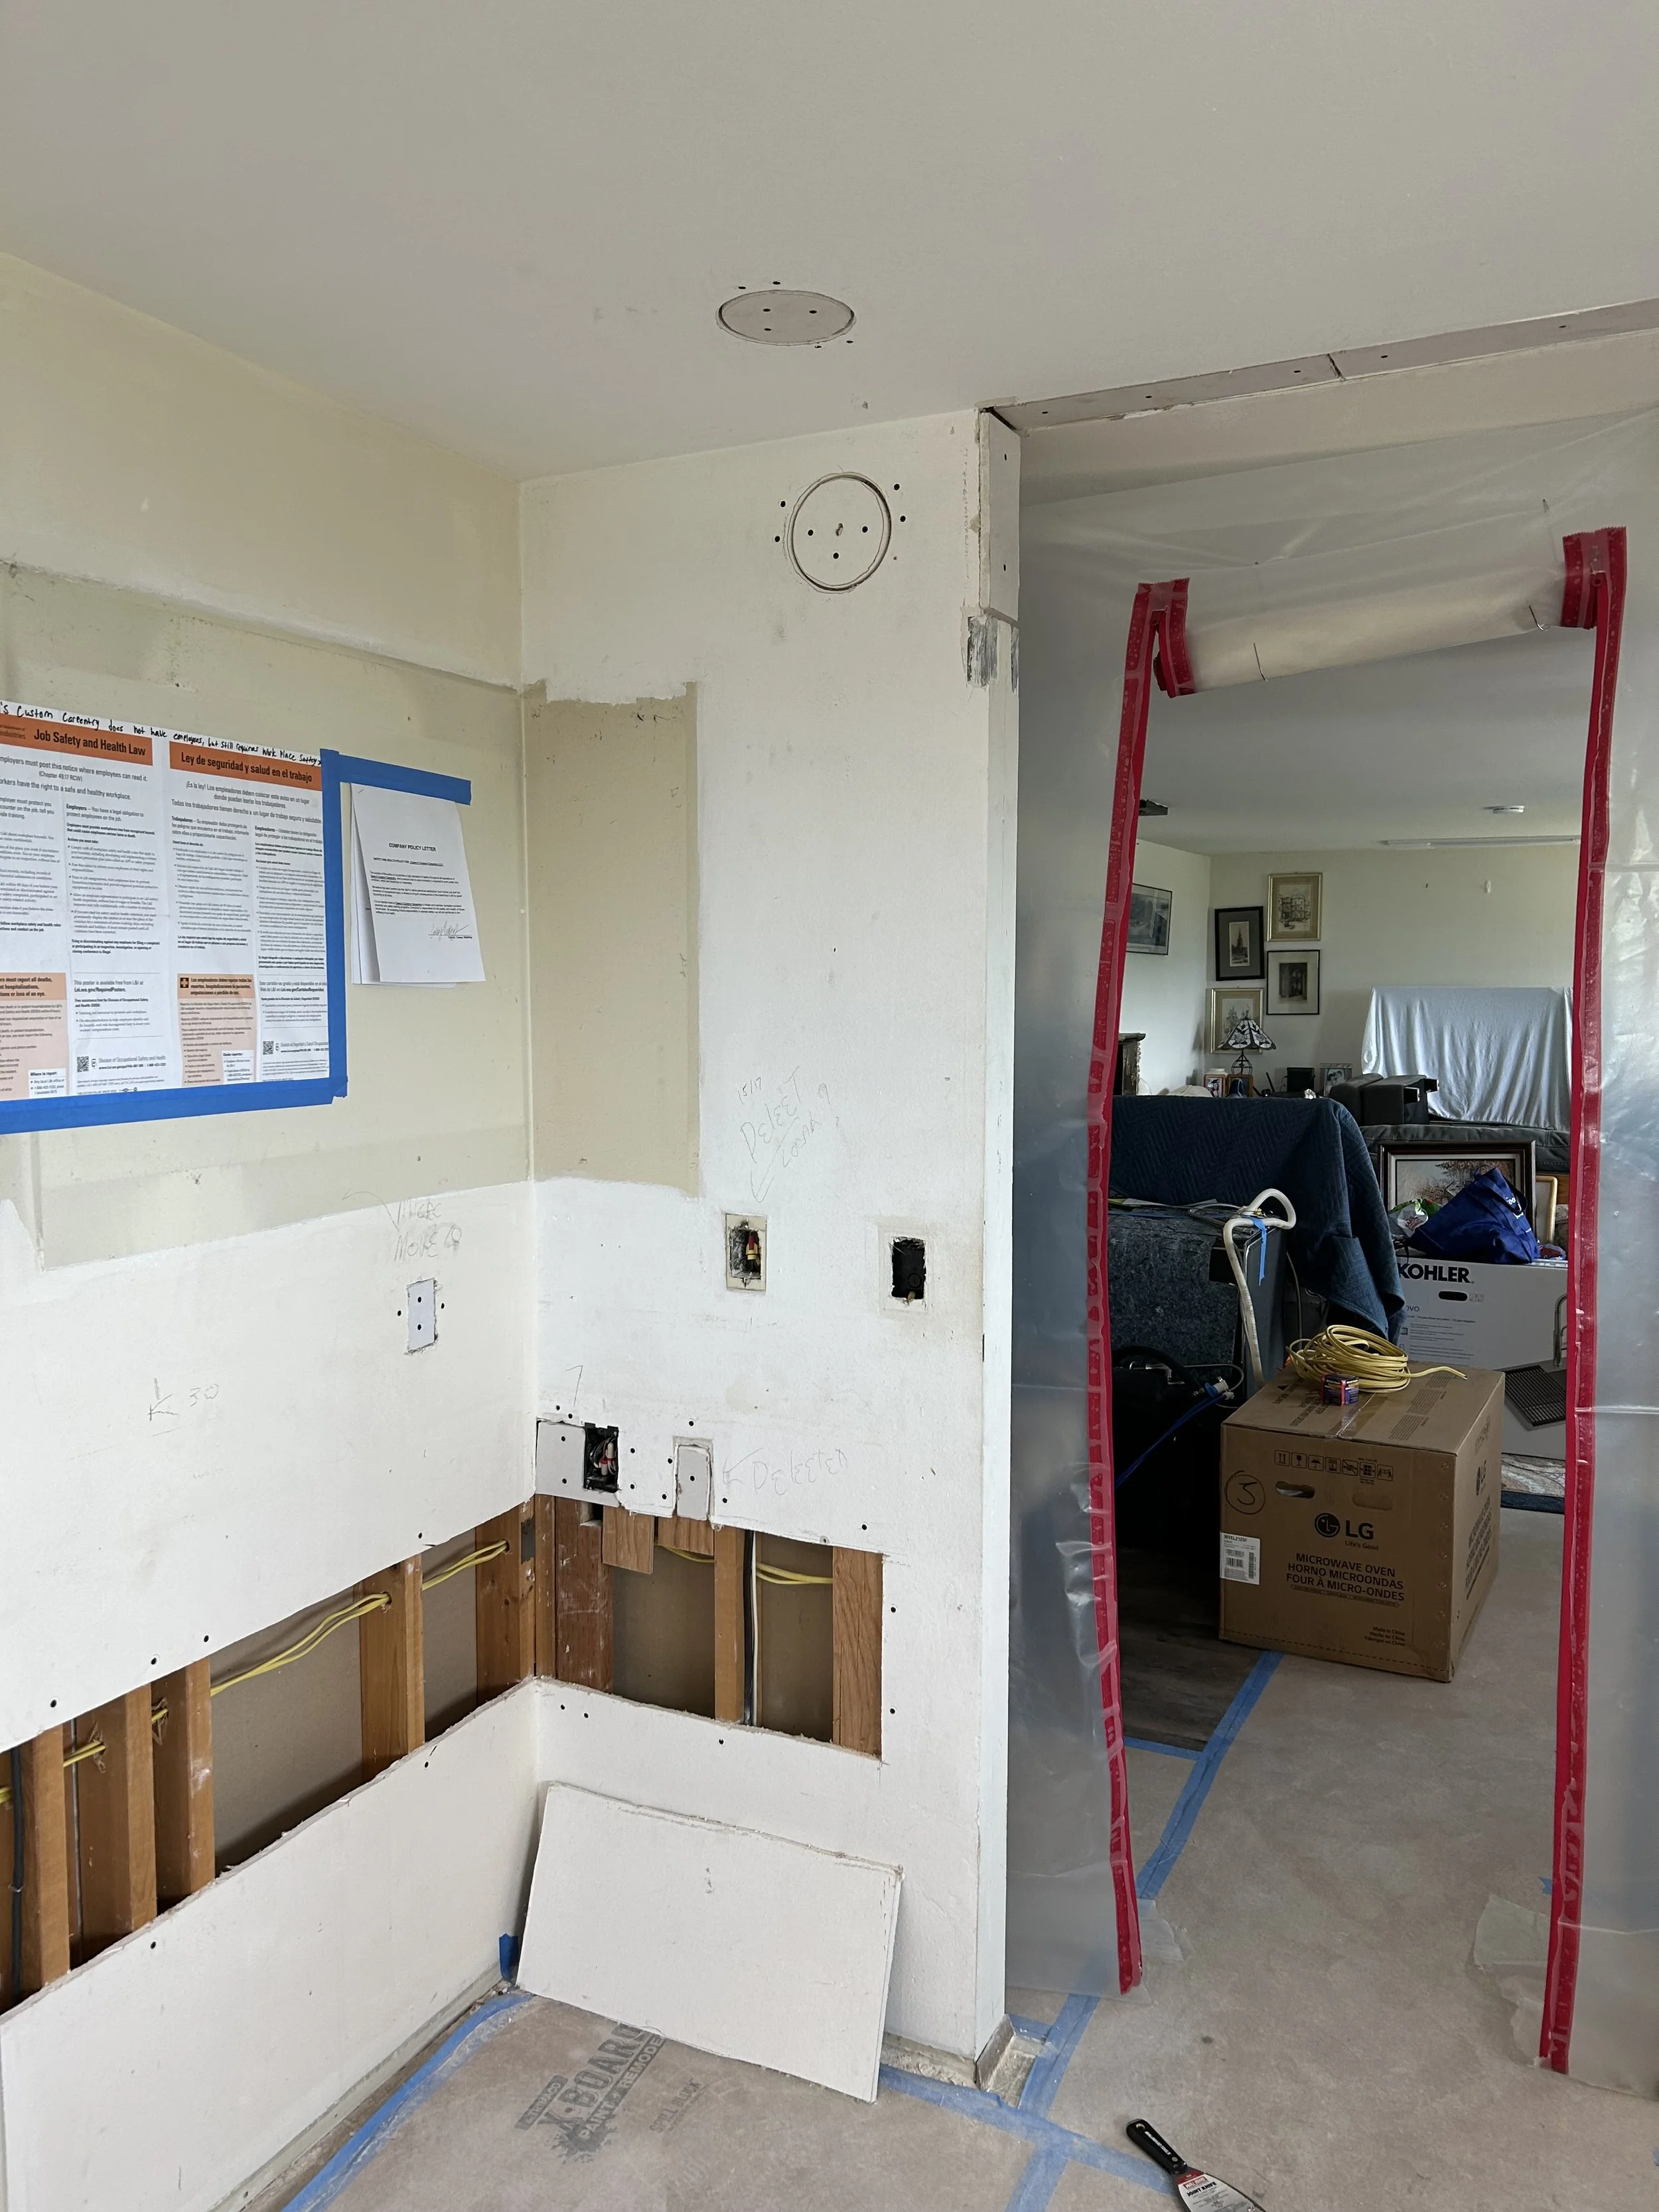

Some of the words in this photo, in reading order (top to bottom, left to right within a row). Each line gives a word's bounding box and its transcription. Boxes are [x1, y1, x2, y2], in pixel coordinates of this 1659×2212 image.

[17, 705, 53, 717] Custom
[108, 719, 123, 731] does
[134, 725, 145, 734] not
[151, 727, 167, 737] have
[208, 737, 218, 747] but
[34, 729, 50, 741] Job
[53, 732, 81, 749] Safety
[83, 738, 98, 749] and
[100, 739, 127, 753] Health
[129, 743, 146, 756] Law
[96, 769, 121, 778] employees
[181, 752, 194, 766] Ley
[196, 755, 206, 765] de
[207, 759, 244, 771] seguridad
[244, 765, 249, 774] y
[251, 765, 270, 775] salud
[272, 769, 280, 777] en
[282, 769, 288, 778] el
[289, 770, 313, 783] trabajo
[17, 779, 30, 788] have
[87, 788, 105, 798] healthy
[1397, 1262, 1471, 1284] KOHLER
[1345, 1520, 1374, 1540] LG
[1362, 1542, 1379, 1551] Good
[1288, 1562, 1327, 1576] HORNO
[1329, 1570, 1404, 1589] MICROONDAS
[1296, 1553, 1362, 1572] MICROWAVE
[1365, 1564, 1396, 1578] OVEN
[1286, 1573, 1315, 1586] FOUR
[1317, 1576, 1325, 1587] À
[1327, 1580, 1405, 1601] MICRO-ONDES
